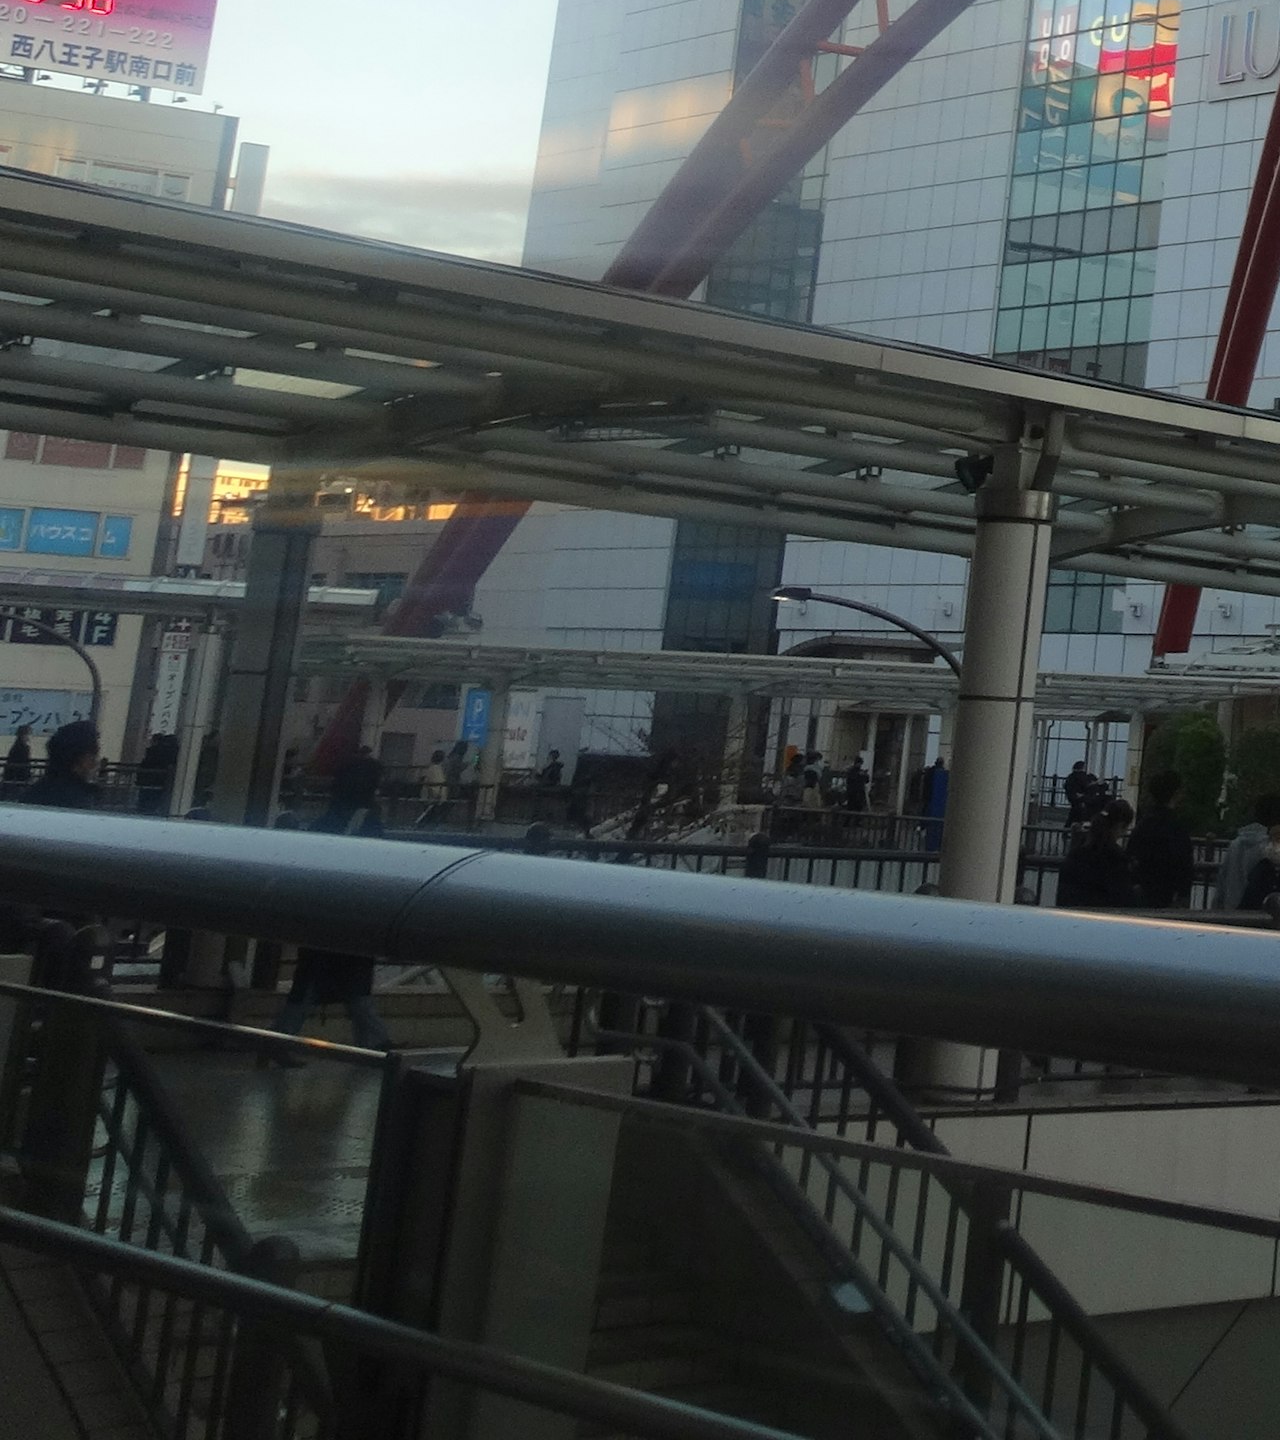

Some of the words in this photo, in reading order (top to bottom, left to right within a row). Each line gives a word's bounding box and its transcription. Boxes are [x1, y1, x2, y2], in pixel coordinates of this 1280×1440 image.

[10, 33, 198, 87] 西八王子駅南口前
